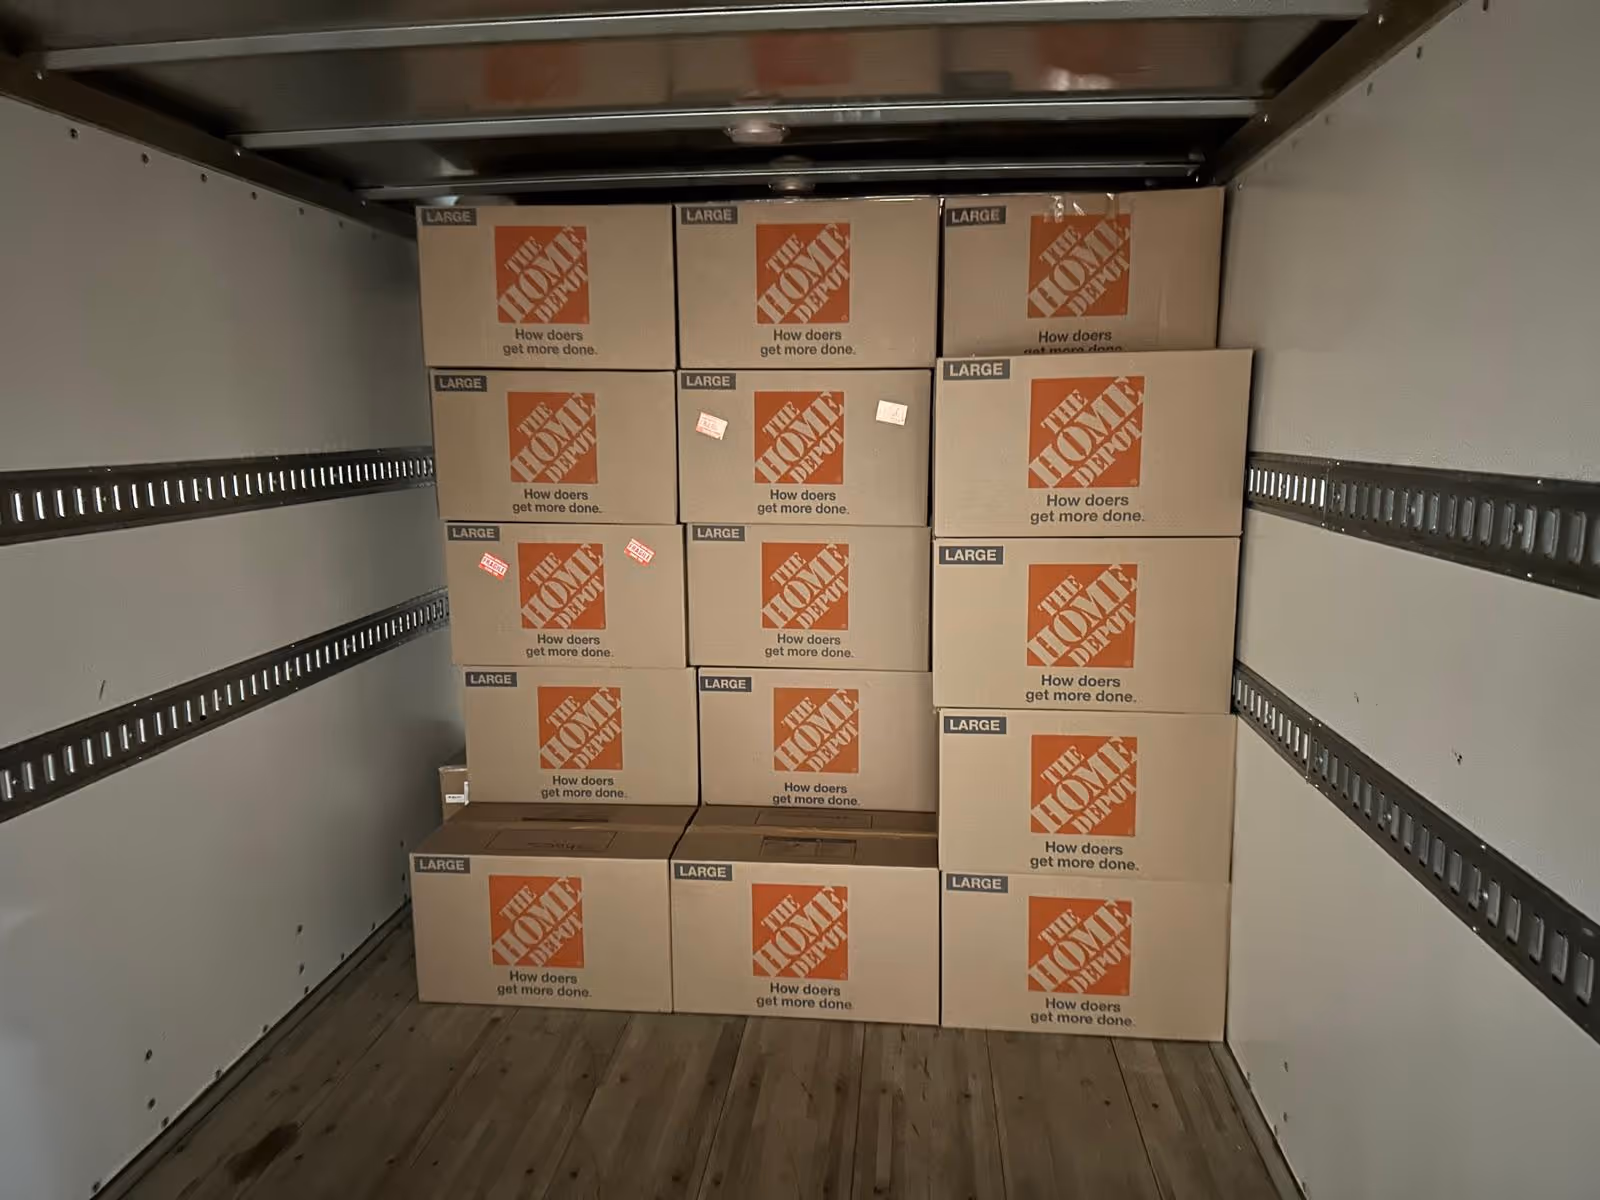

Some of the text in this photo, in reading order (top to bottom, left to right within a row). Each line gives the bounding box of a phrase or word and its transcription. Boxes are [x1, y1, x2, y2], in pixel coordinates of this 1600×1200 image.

[426, 209, 472, 224] LARGE
[686, 207, 732, 222] LARGE
[951, 209, 1000, 222] LARGE
[504, 235, 542, 275] THE
[764, 233, 805, 275] THE
[1038, 224, 1082, 267] THE
[497, 225, 588, 323] HOME
[757, 223, 851, 323] HOME
[1028, 212, 1132, 317] HOME
[533, 262, 589, 323] DEPOT
[793, 260, 851, 323] DEPOT
[1066, 250, 1131, 317] DEPOT
[502, 344, 599, 357] get more done.
[514, 329, 584, 341] How doers
[760, 344, 856, 357] get more done.
[773, 329, 842, 341] How doers
[1037, 329, 1113, 342] How doers
[439, 375, 482, 390] LARGE
[686, 374, 731, 387] LARGE
[949, 362, 1003, 377] LARGE
[516, 401, 553, 438] THE
[762, 401, 800, 438] THE
[1040, 389, 1088, 435] THE
[510, 392, 596, 482] HOME
[754, 391, 845, 483] HOME
[1029, 376, 1145, 488] HOME
[544, 427, 597, 483] DEPOT
[788, 425, 844, 484] DEPOT
[1071, 417, 1143, 488] DEPOT
[512, 502, 532, 514] get
[534, 503, 566, 513] more
[523, 488, 588, 501] How doers
[757, 503, 850, 515] get more done.
[770, 489, 836, 501] How doers
[1046, 494, 1129, 507] How doers
[452, 526, 495, 540] LARGE
[697, 526, 740, 540] LARGE
[1030, 510, 1145, 525] get more done.
[526, 551, 562, 587] THE
[769, 551, 806, 587] THE
[945, 547, 996, 563] LARGE
[521, 543, 604, 628] HOME
[554, 575, 605, 629] DEPOT
[762, 543, 849, 628] HOME
[796, 576, 849, 629] DEPOT
[1037, 574, 1084, 616] THE
[1027, 563, 1138, 666] HOME
[537, 634, 600, 645] How doers
[777, 633, 841, 645] How doers
[1068, 602, 1137, 667] DEPOT
[526, 647, 545, 658] get
[547, 647, 578, 657] more
[765, 647, 854, 658] get more done.
[470, 672, 512, 685] LARGE
[704, 677, 747, 690] LARGE
[1041, 674, 1120, 688] How doers
[546, 695, 581, 729] THE
[781, 696, 817, 730] THE
[1026, 690, 1137, 704] get more done.
[540, 686, 622, 769] HOME
[774, 689, 859, 771] HOME
[949, 717, 999, 732] LARGE
[572, 717, 623, 769] DEPOT
[806, 720, 859, 772] DEPOT
[552, 775, 614, 786] How doers
[1040, 745, 1086, 785] THE
[541, 788, 560, 799] get
[562, 788, 592, 798] more
[772, 794, 792, 805] get
[794, 794, 825, 805] more
[784, 782, 847, 794] How doers
[1031, 736, 1138, 833] HOME
[1071, 773, 1137, 835] DEPOT
[419, 858, 465, 872] LARGE
[1030, 856, 1139, 872] get more done.
[1045, 841, 1124, 856] How doers
[679, 864, 727, 879] LARGE
[952, 874, 1002, 891] LARGE
[492, 876, 583, 965] HOME
[498, 885, 536, 922] THE
[760, 894, 801, 931] THE
[527, 911, 584, 967] DEPOT
[752, 885, 848, 976] HOME
[1037, 907, 1082, 946] THE
[789, 921, 849, 978] DEPOT
[1028, 899, 1133, 992] HOME
[509, 970, 578, 984] How doers
[1067, 936, 1132, 994] DEPOT
[497, 984, 593, 998] get more done.
[756, 995, 778, 1008] get
[780, 996, 816, 1009] more
[769, 982, 842, 997] How doers
[1045, 998, 1121, 1013] How doers
[1030, 1011, 1053, 1025] get
[1056, 1013, 1093, 1025] more
